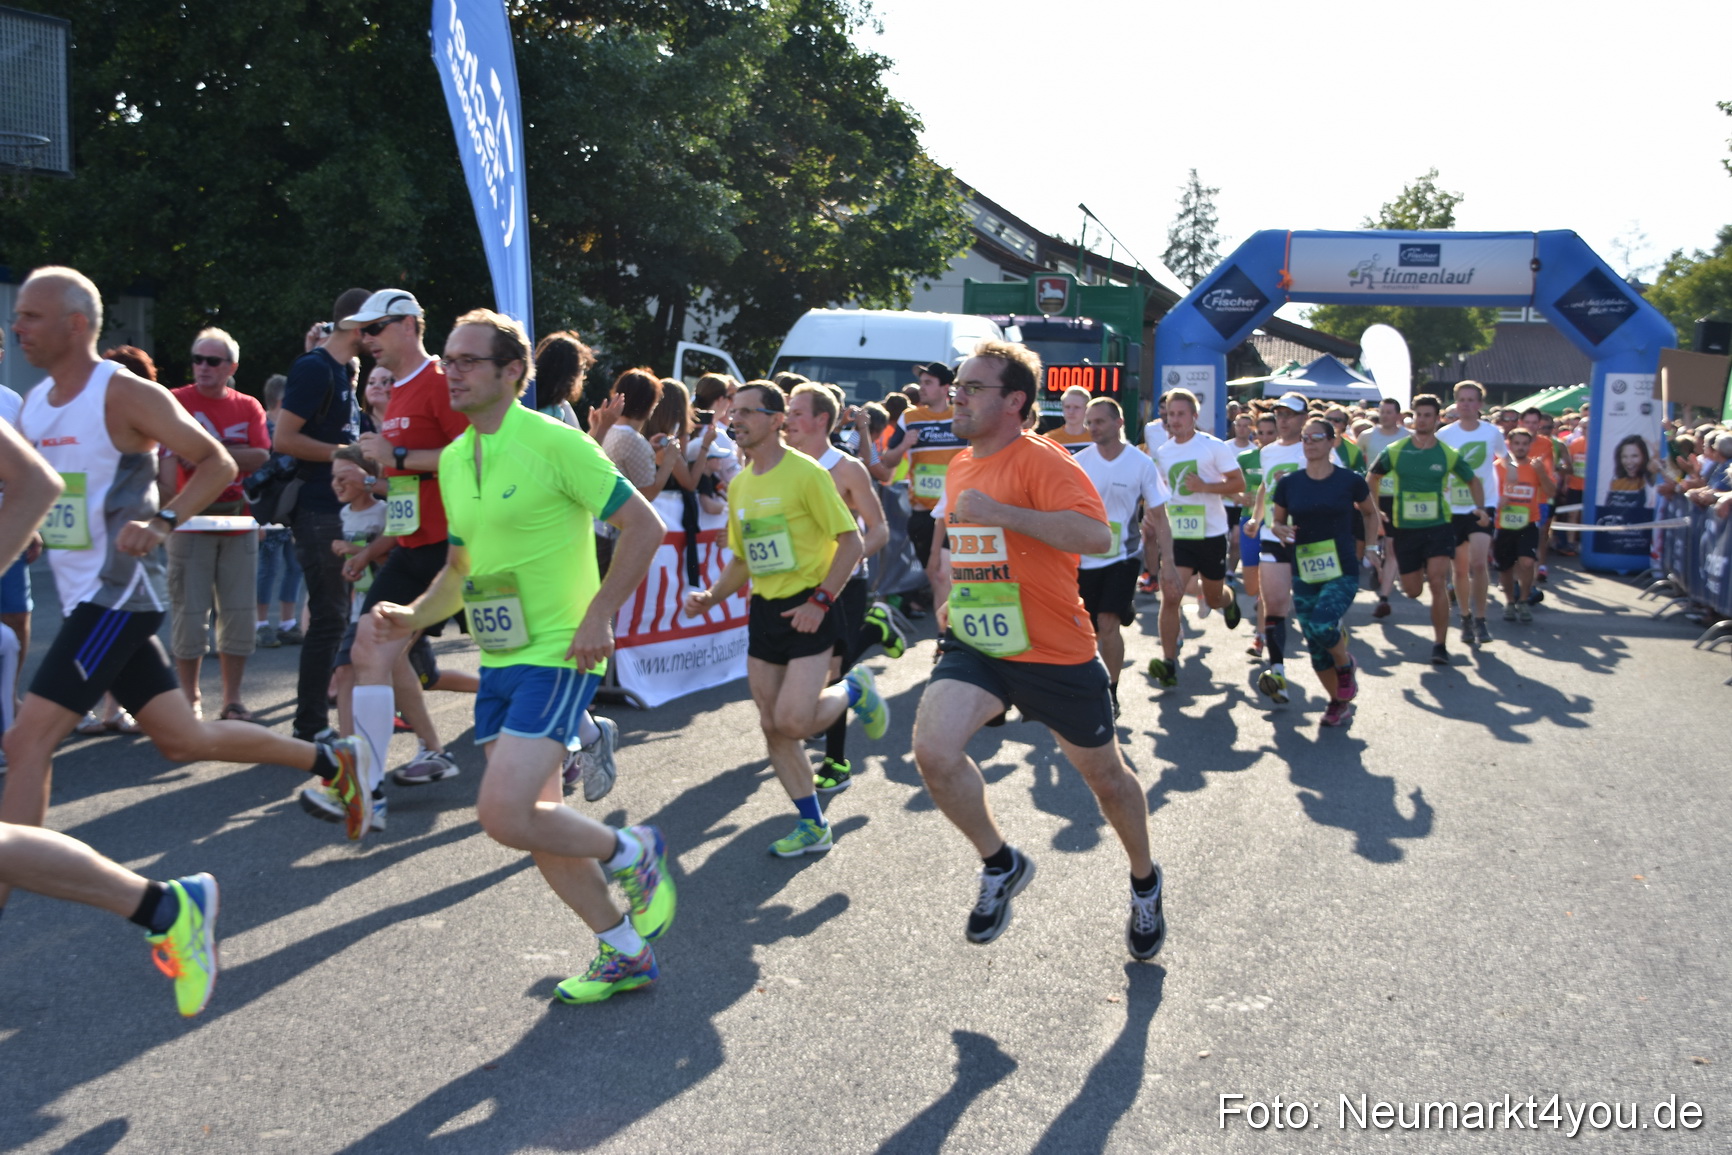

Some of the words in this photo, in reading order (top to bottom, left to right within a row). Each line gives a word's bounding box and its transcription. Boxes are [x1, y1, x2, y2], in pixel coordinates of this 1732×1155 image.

[1382, 268, 1476, 285] firmenlauf
[1211, 296, 1260, 308] Fischer
[920, 477, 942, 489] 450
[1413, 503, 1428, 513] 19
[1176, 518, 1198, 530] 130
[748, 540, 779, 562] 631
[1302, 556, 1335, 573] 1294
[472, 605, 513, 633] 656
[963, 612, 1009, 637] 616
